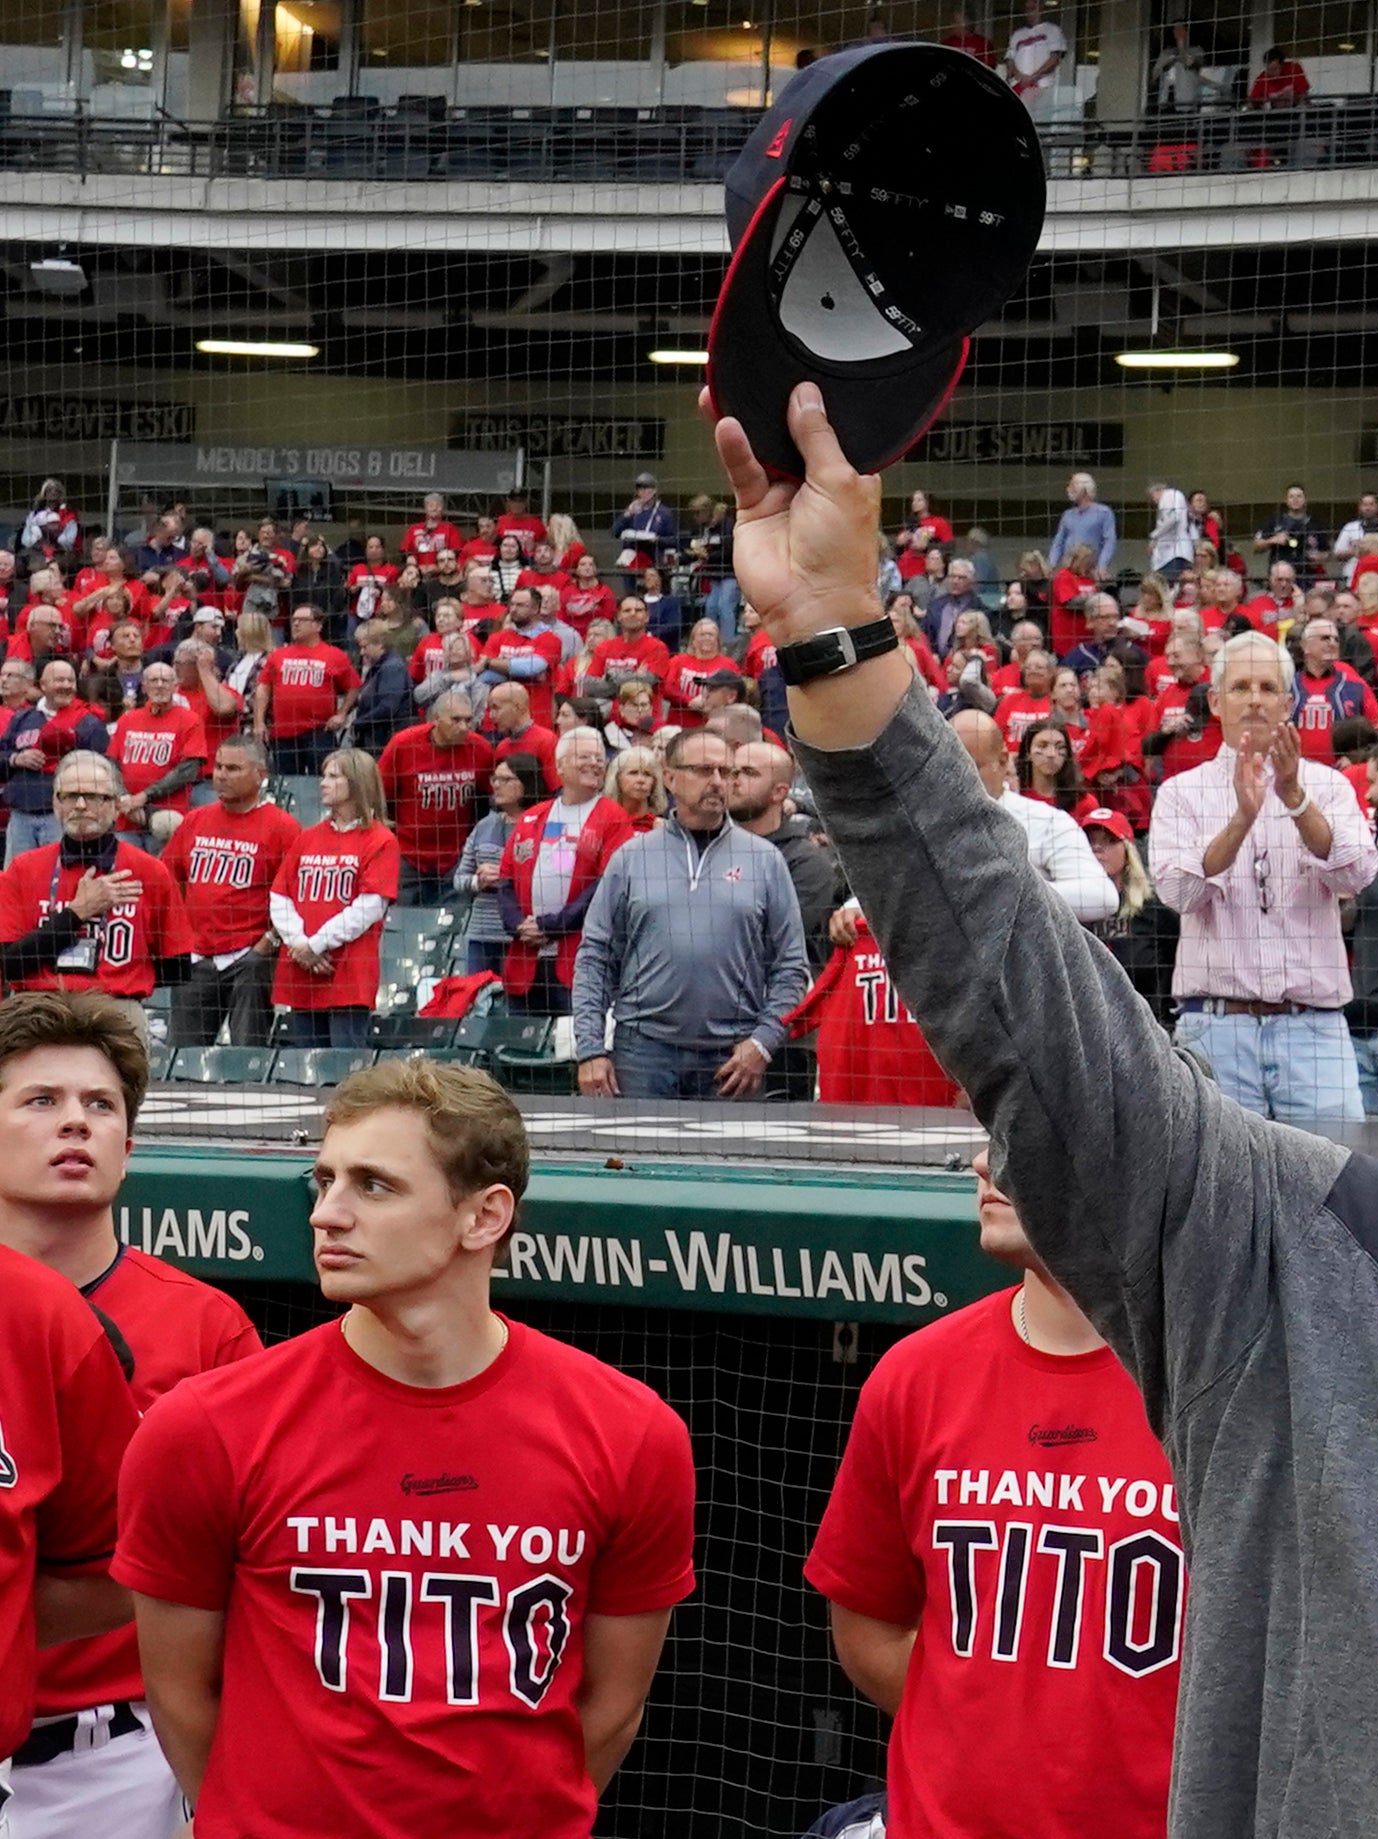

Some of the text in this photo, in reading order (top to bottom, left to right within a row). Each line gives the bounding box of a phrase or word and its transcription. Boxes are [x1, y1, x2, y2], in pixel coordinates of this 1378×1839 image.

[933, 425, 1091, 460] JOE SEWELL
[197, 446, 298, 474] MENDEL'S
[306, 448, 359, 476] DOGS
[390, 452, 436, 478] DELI
[194, 835, 259, 855] THANK YOU
[301, 855, 337, 867] THANK
[189, 847, 255, 889] TITO
[298, 866, 358, 904] TITO
[1028, 1423, 1099, 1448] Guardians
[400, 1473, 480, 1497] Guardians
[934, 1469, 1180, 1523] THANK YOU
[287, 1516, 586, 1566] THANK YOU
[932, 1519, 1185, 1679] TITO
[290, 1566, 574, 1710] TITO
